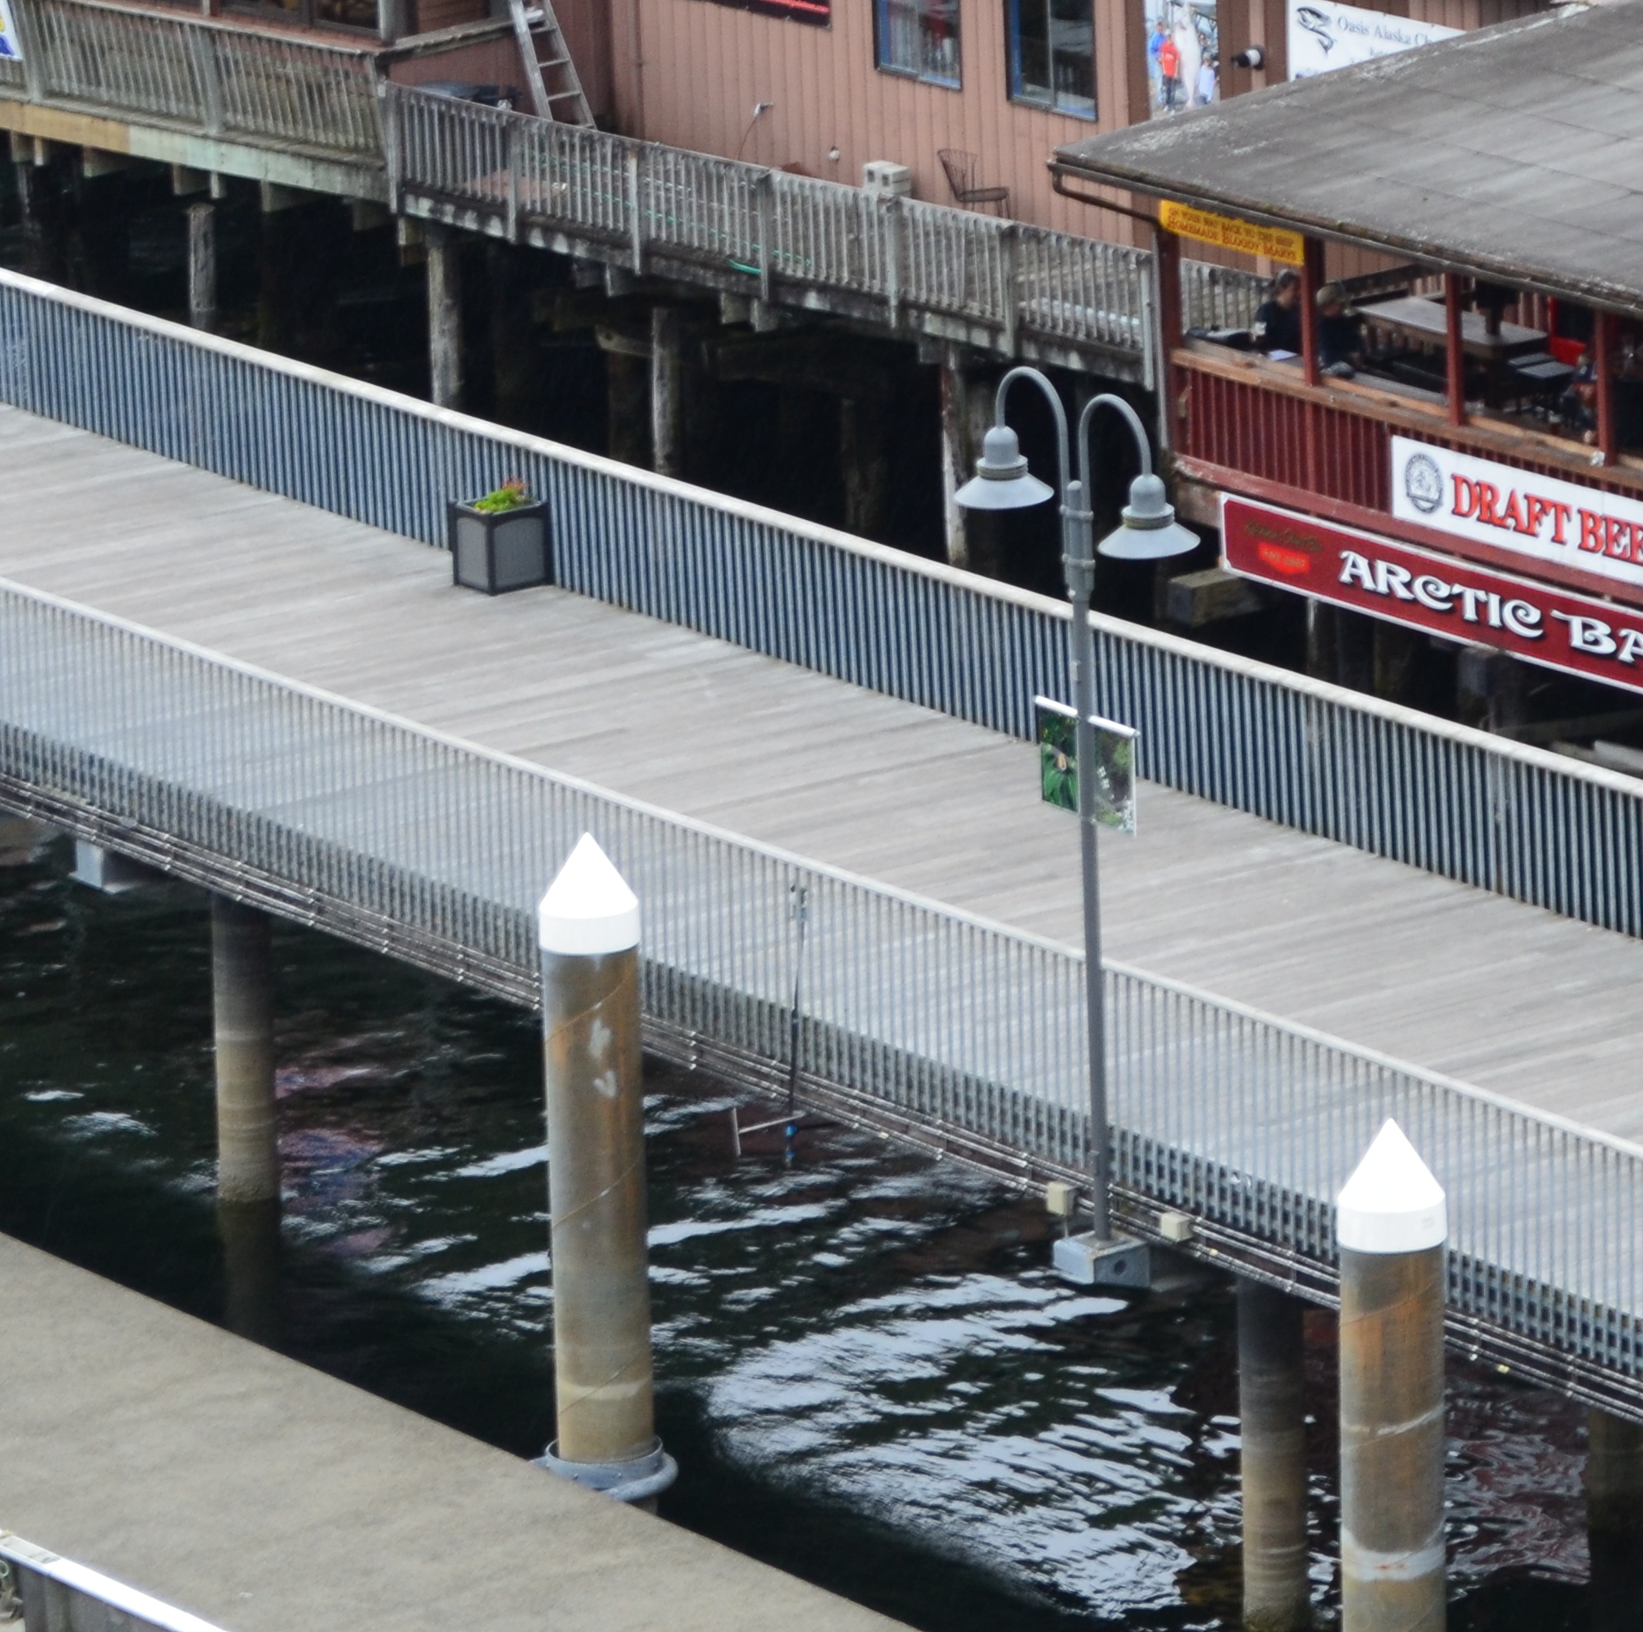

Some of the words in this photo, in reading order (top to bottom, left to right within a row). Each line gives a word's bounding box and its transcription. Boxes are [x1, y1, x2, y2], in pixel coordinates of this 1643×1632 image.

[1337, 16, 1370, 36] Oasis
[1374, 24, 1411, 45] Alaska
[1222, 232, 1259, 249] BLOODY
[1451, 473, 1572, 544] DRAFT
[1339, 550, 1545, 639] ARCTIC
